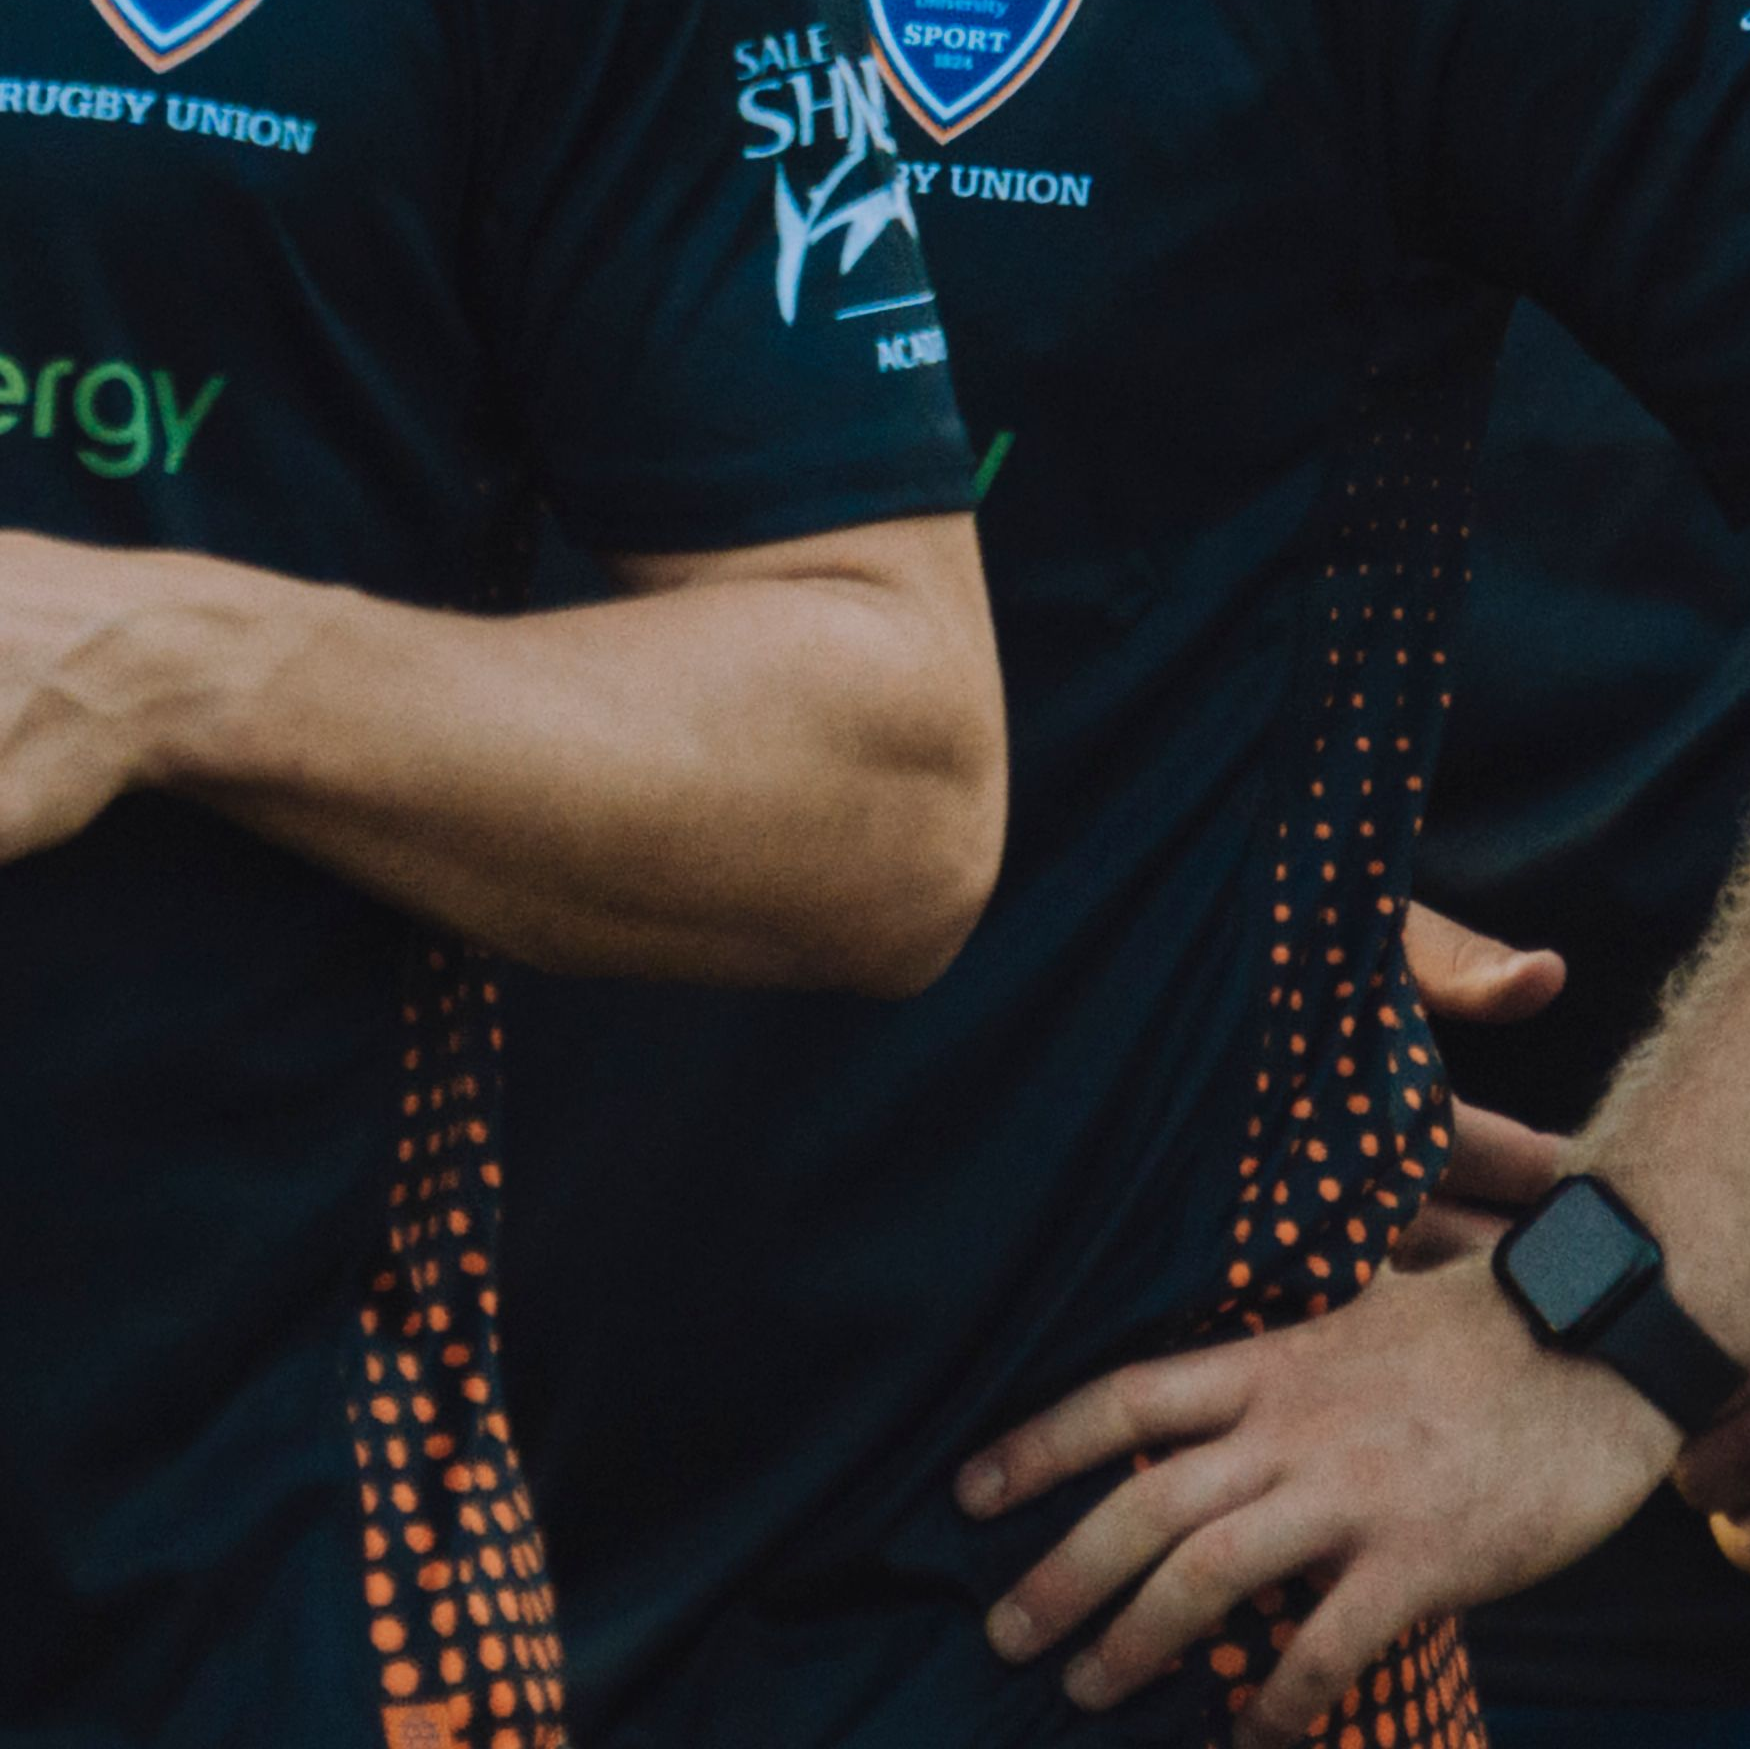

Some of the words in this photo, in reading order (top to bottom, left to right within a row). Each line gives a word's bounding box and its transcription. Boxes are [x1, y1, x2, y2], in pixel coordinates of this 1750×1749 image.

[733, 22, 833, 81] SALE
[903, 21, 1011, 54] SPORT
[0, 76, 156, 125] RUGBY
[166, 97, 318, 155] UNION
[950, 164, 1094, 207] UNION
